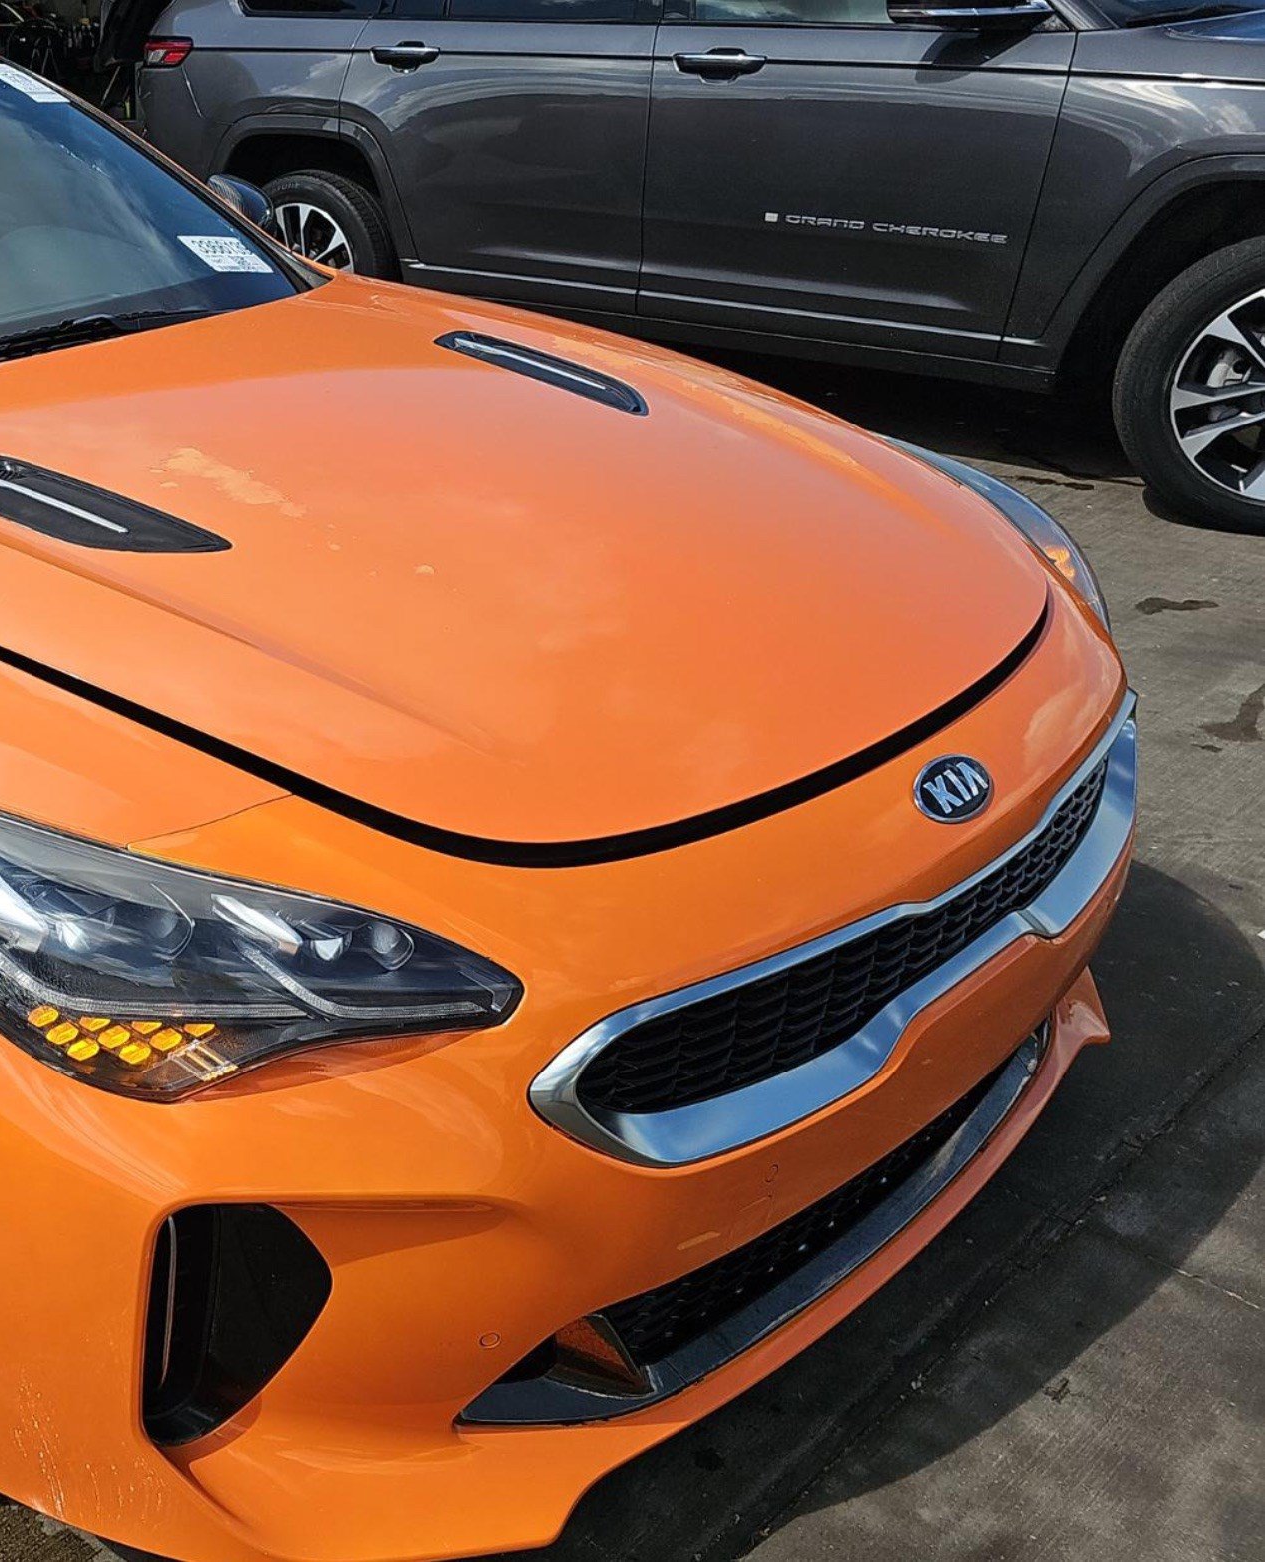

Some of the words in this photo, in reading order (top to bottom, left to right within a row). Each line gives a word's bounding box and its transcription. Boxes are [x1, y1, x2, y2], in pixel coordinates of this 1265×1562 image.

[785, 214, 865, 230] GRAND
[872, 222, 1008, 244] CHEROKEE
[922, 761, 989, 815] KIA
